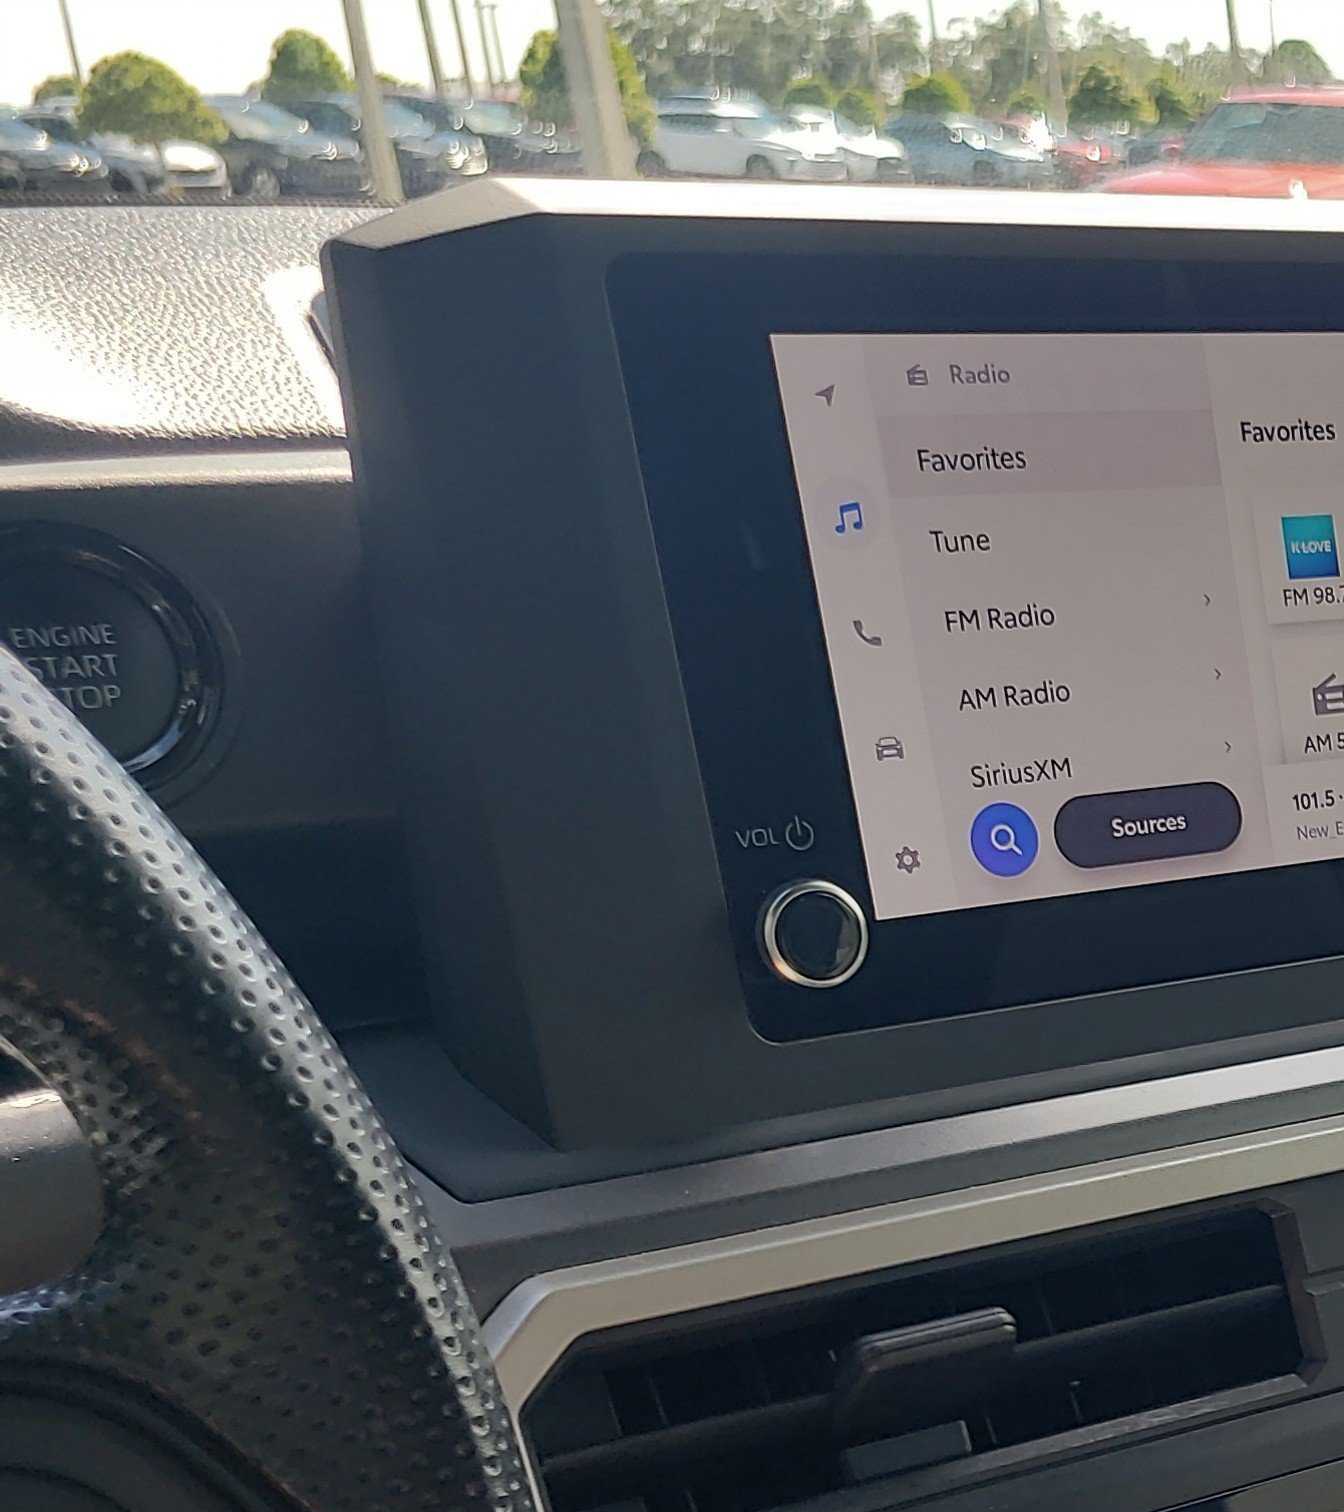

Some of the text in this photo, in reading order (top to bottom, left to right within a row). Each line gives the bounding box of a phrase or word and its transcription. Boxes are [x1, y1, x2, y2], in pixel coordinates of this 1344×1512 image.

[949, 363, 1011, 386] Radio
[1240, 419, 1337, 443] Favorites
[916, 446, 1027, 472] Favorites
[929, 529, 992, 554] Tune
[1283, 588, 1308, 607] FM
[944, 603, 1056, 633] FM Radio
[8, 623, 118, 649] ENGINE
[50, 684, 121, 710] TOP
[958, 681, 1071, 711] AM Radio
[1304, 734, 1335, 754] AM
[970, 757, 1073, 789] SiriusXM
[1292, 789, 1336, 812] 101.5
[735, 827, 780, 850] VOL
[1111, 813, 1187, 840] Sources
